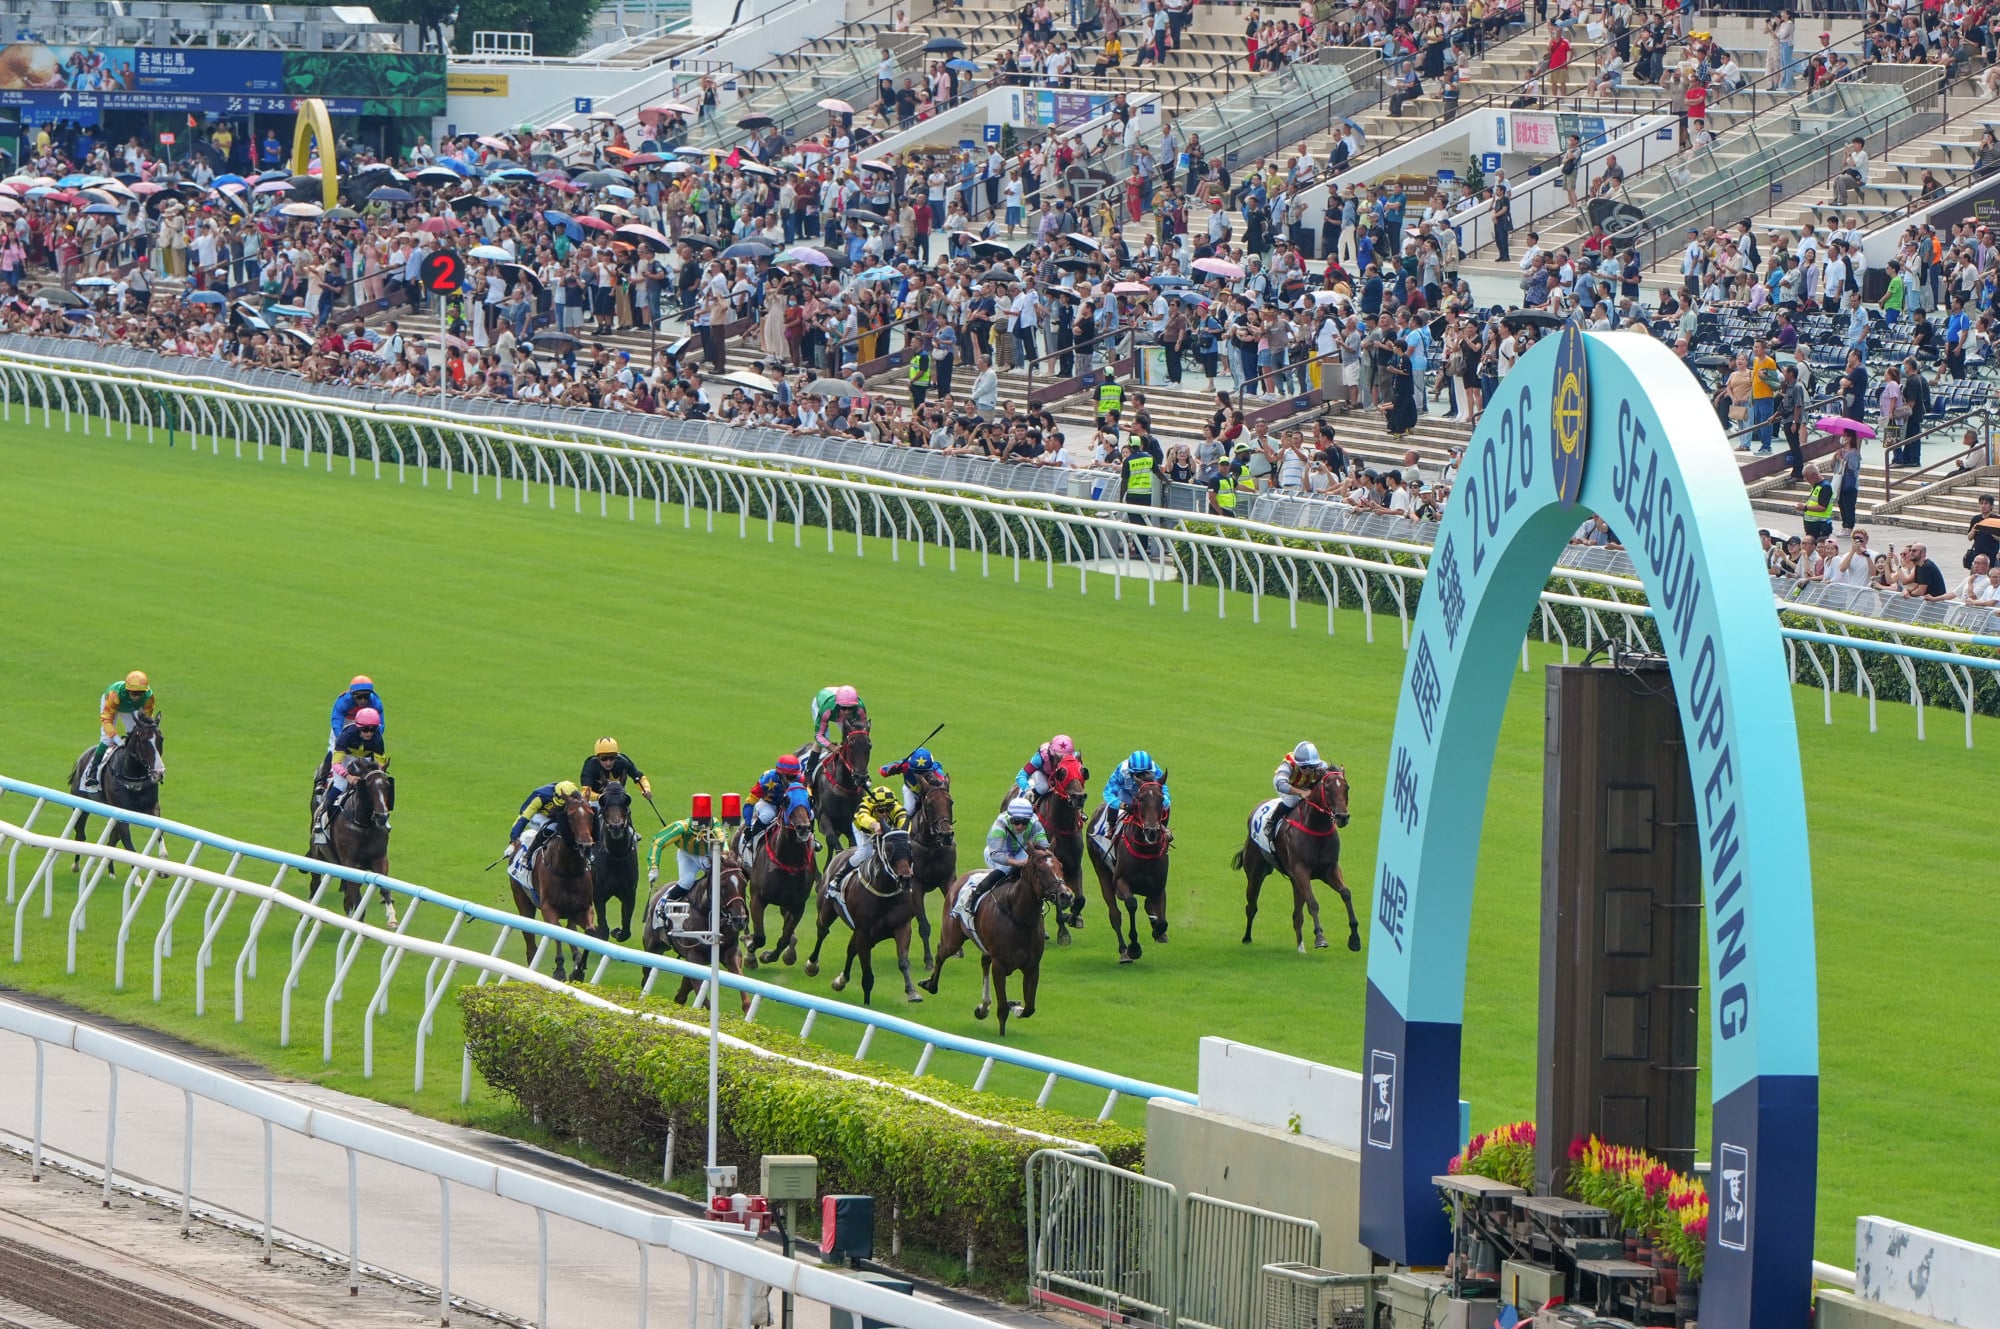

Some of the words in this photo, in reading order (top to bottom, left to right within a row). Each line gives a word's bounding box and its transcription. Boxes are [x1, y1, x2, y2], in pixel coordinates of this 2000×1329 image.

[139, 52, 185, 67] 全城出馬
[139, 66, 150, 74] THE
[151, 66, 162, 74] CITY
[187, 67, 195, 75] UP
[268, 100, 285, 110] 2-6
[578, 100, 587, 112] F
[987, 128, 996, 139] F
[1486, 156, 1495, 170] E
[432, 255, 456, 289] 2
[1464, 384, 1535, 577] 2026
[1613, 398, 1701, 661] SEASON
[1689, 634, 1749, 1041] OPENING
